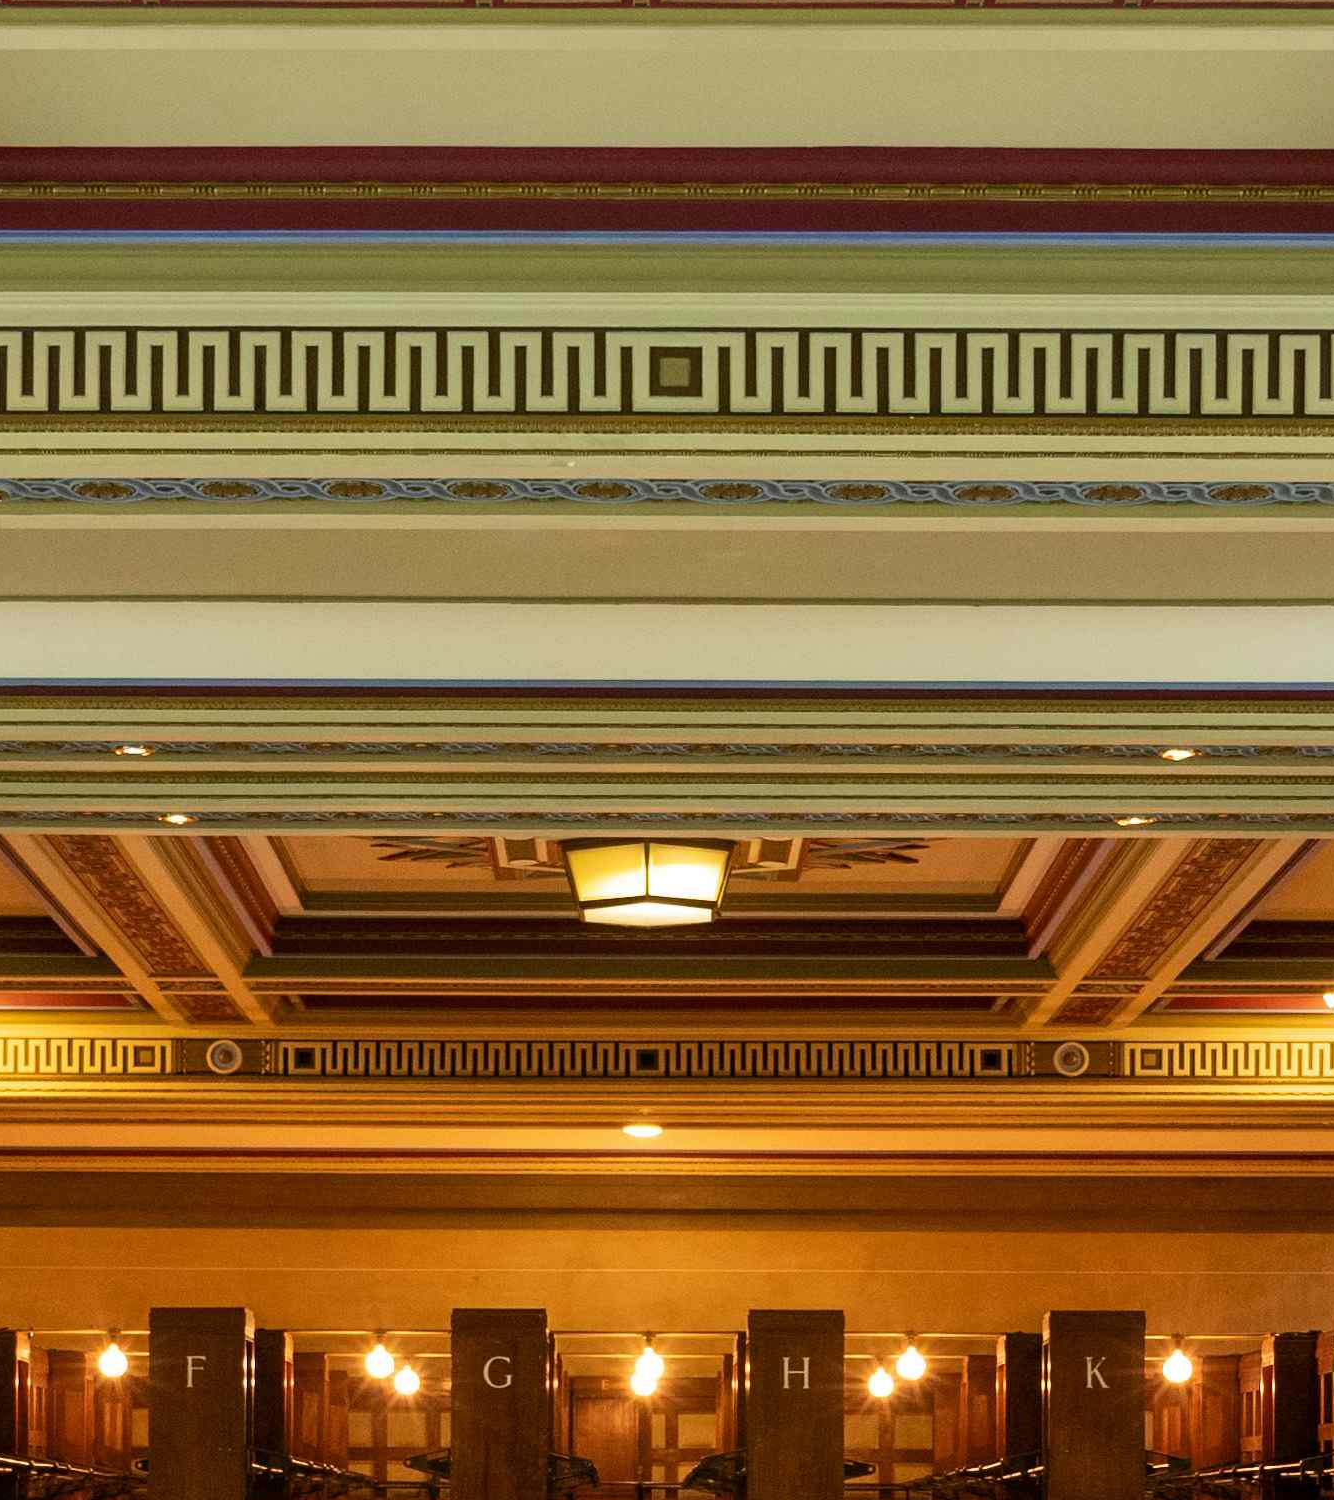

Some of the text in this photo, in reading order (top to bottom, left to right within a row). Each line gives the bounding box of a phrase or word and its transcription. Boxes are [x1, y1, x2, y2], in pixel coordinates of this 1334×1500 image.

[186, 1355, 207, 1388] F
[483, 1355, 512, 1389] G
[782, 1357, 810, 1389] H
[1085, 1357, 1110, 1389] K
